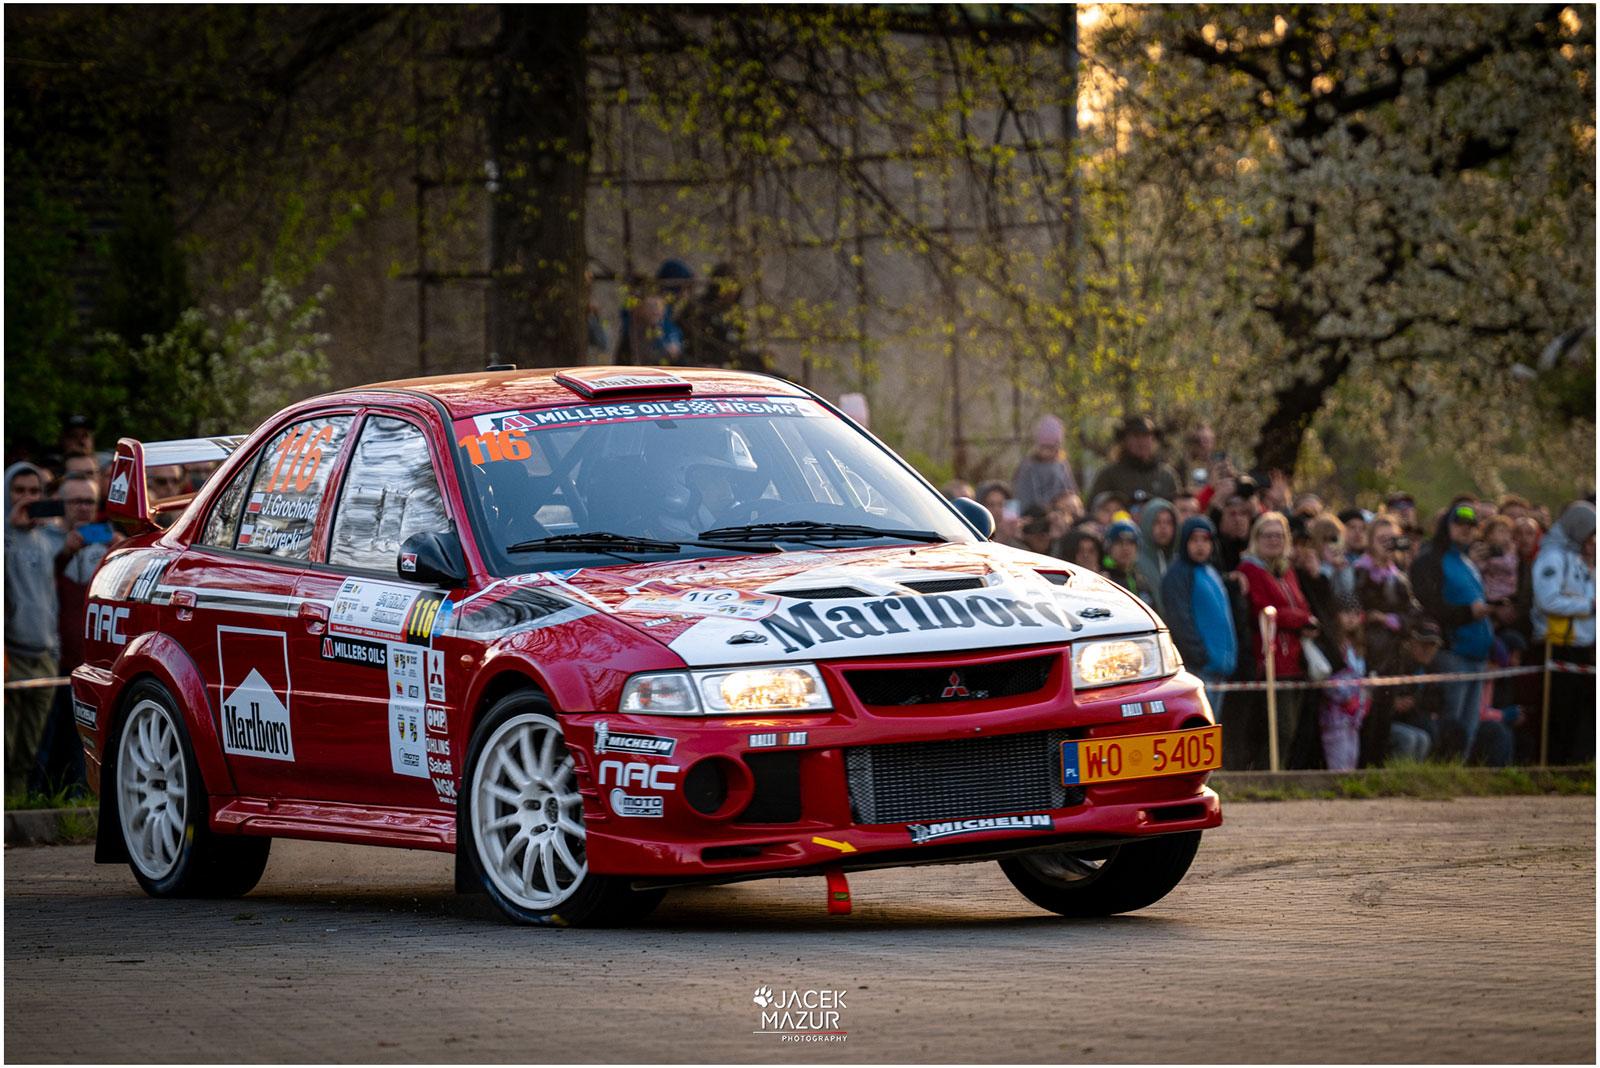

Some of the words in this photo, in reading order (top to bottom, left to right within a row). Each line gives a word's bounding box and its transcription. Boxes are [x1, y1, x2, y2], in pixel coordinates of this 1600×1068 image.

[537, 404, 635, 424] MILLERS
[638, 401, 690, 415] OILS
[715, 401, 797, 416] HRSMP
[266, 425, 333, 493] 116
[459, 430, 532, 466] 116
[261, 494, 316, 519] J.Grochola
[688, 592, 734, 602] 116
[85, 603, 130, 645] NAC
[409, 598, 440, 638] 116
[760, 594, 1083, 654] Marlboro
[334, 641, 367, 661] MILLERS
[368, 647, 386, 664] OILS
[224, 702, 289, 755] Marlboro
[427, 709, 446, 728] OMP
[608, 736, 672, 751] MICHELIN
[1085, 743, 1122, 779] WO
[1152, 732, 1215, 771] 5405
[428, 756, 453, 775] Sabelt
[598, 760, 681, 790] NAC
[1065, 768, 1078, 777] PL
[432, 777, 458, 797] NGK
[930, 814, 1050, 834] MICHELIN
